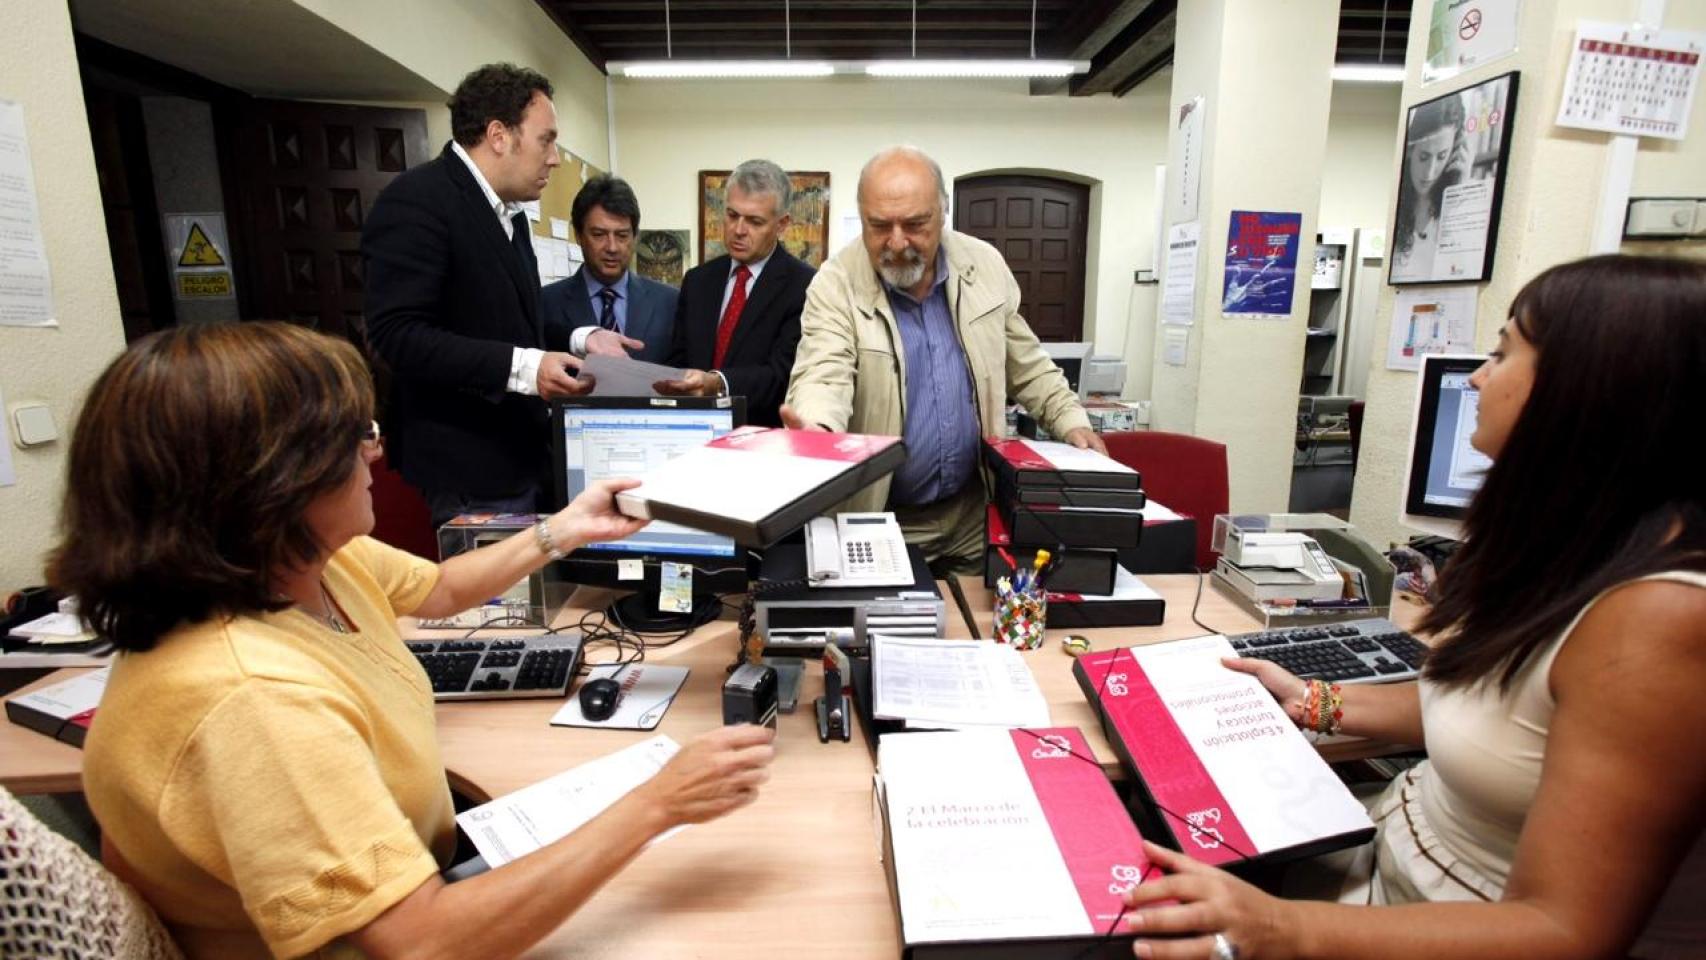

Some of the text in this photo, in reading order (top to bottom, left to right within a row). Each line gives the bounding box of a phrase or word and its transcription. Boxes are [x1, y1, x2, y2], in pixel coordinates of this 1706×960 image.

[184, 275, 225, 285] PELIGRO
[1169, 686, 1257, 710] promocionales
[1214, 699, 1264, 715] acciones
[1216, 719, 1224, 729] y
[1277, 725, 1285, 735] 4
[906, 801, 1021, 816] 2 El Marco de
[906, 818, 923, 829] la
